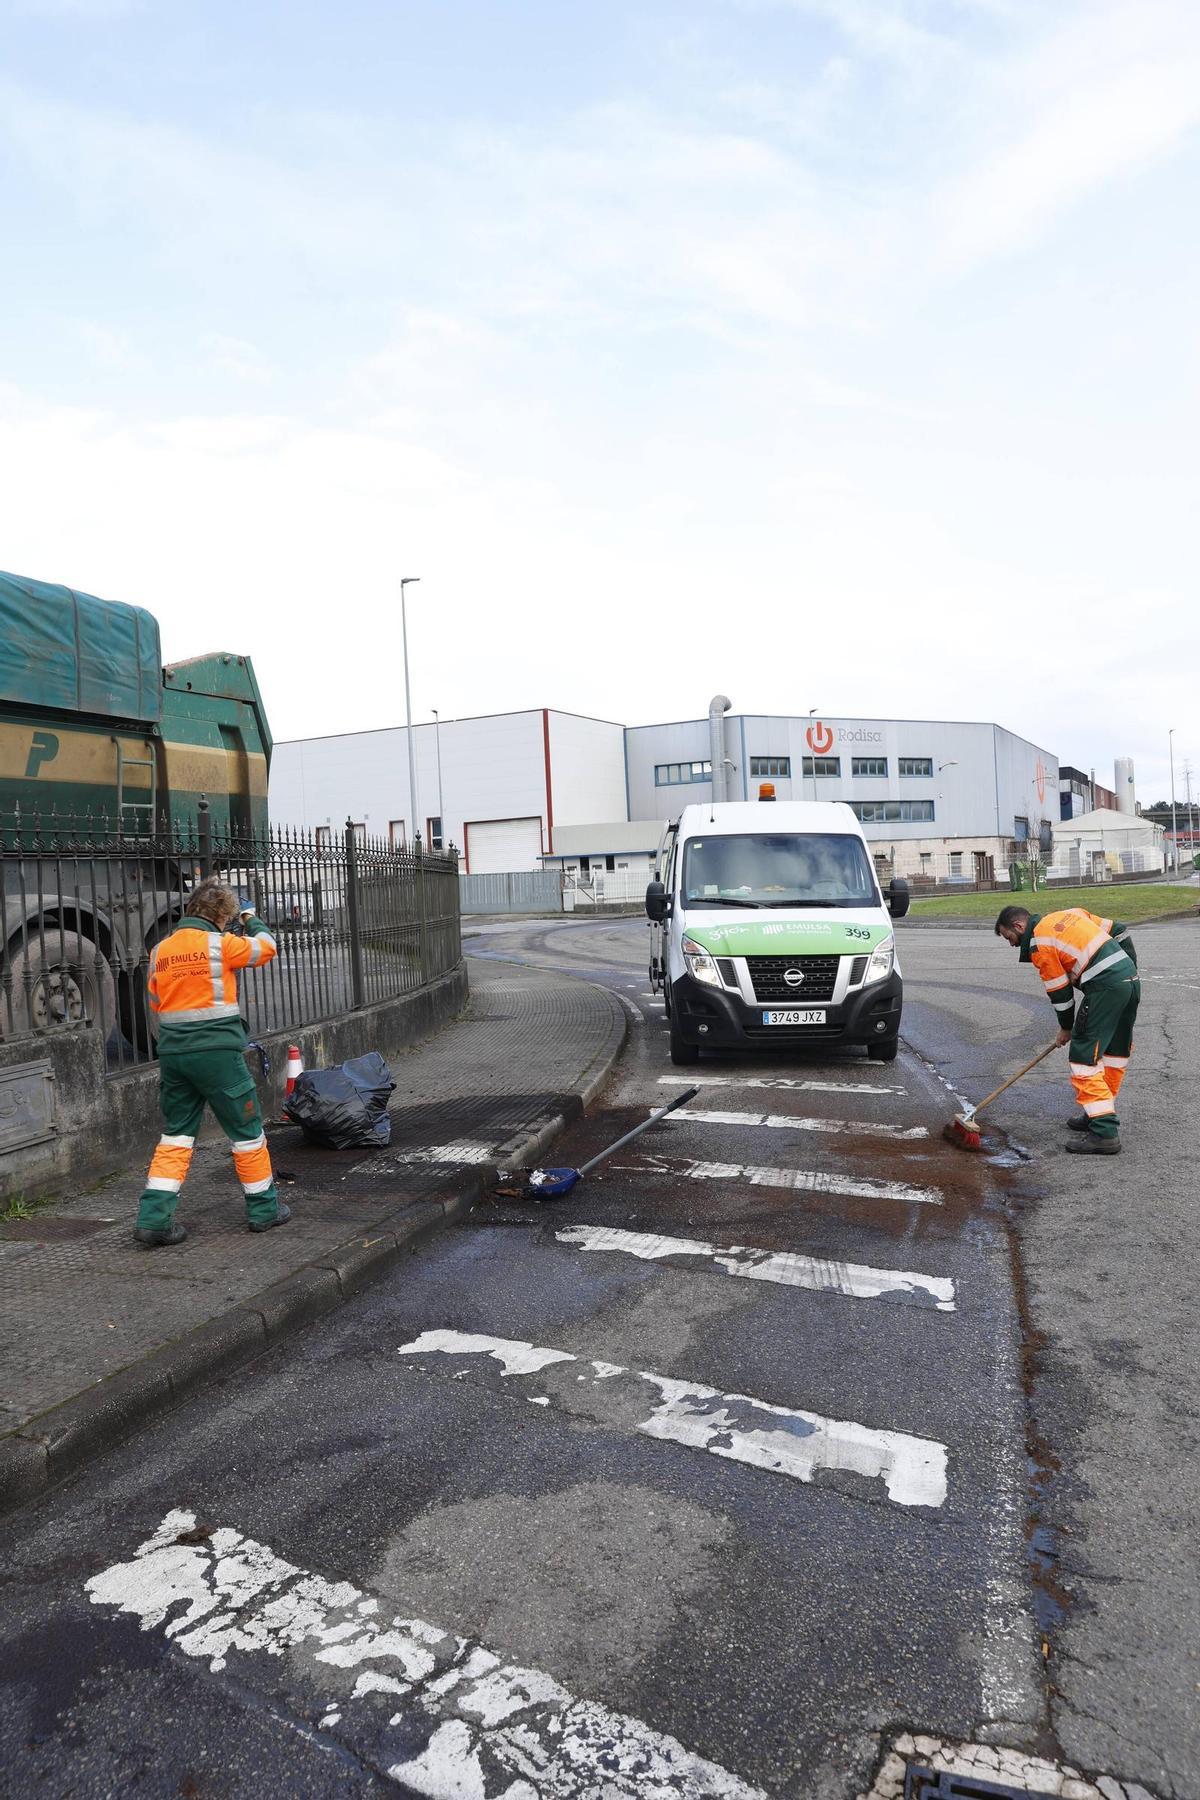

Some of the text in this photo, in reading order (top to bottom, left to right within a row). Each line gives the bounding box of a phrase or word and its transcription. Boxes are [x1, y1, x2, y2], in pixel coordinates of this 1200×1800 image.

[837, 727, 883, 742] Rodisa
[25, 731, 60, 778] P
[844, 927, 871, 940] 399
[170, 951, 207, 965] EMULSA
[771, 1011, 822, 1023] 3749 JXZ
